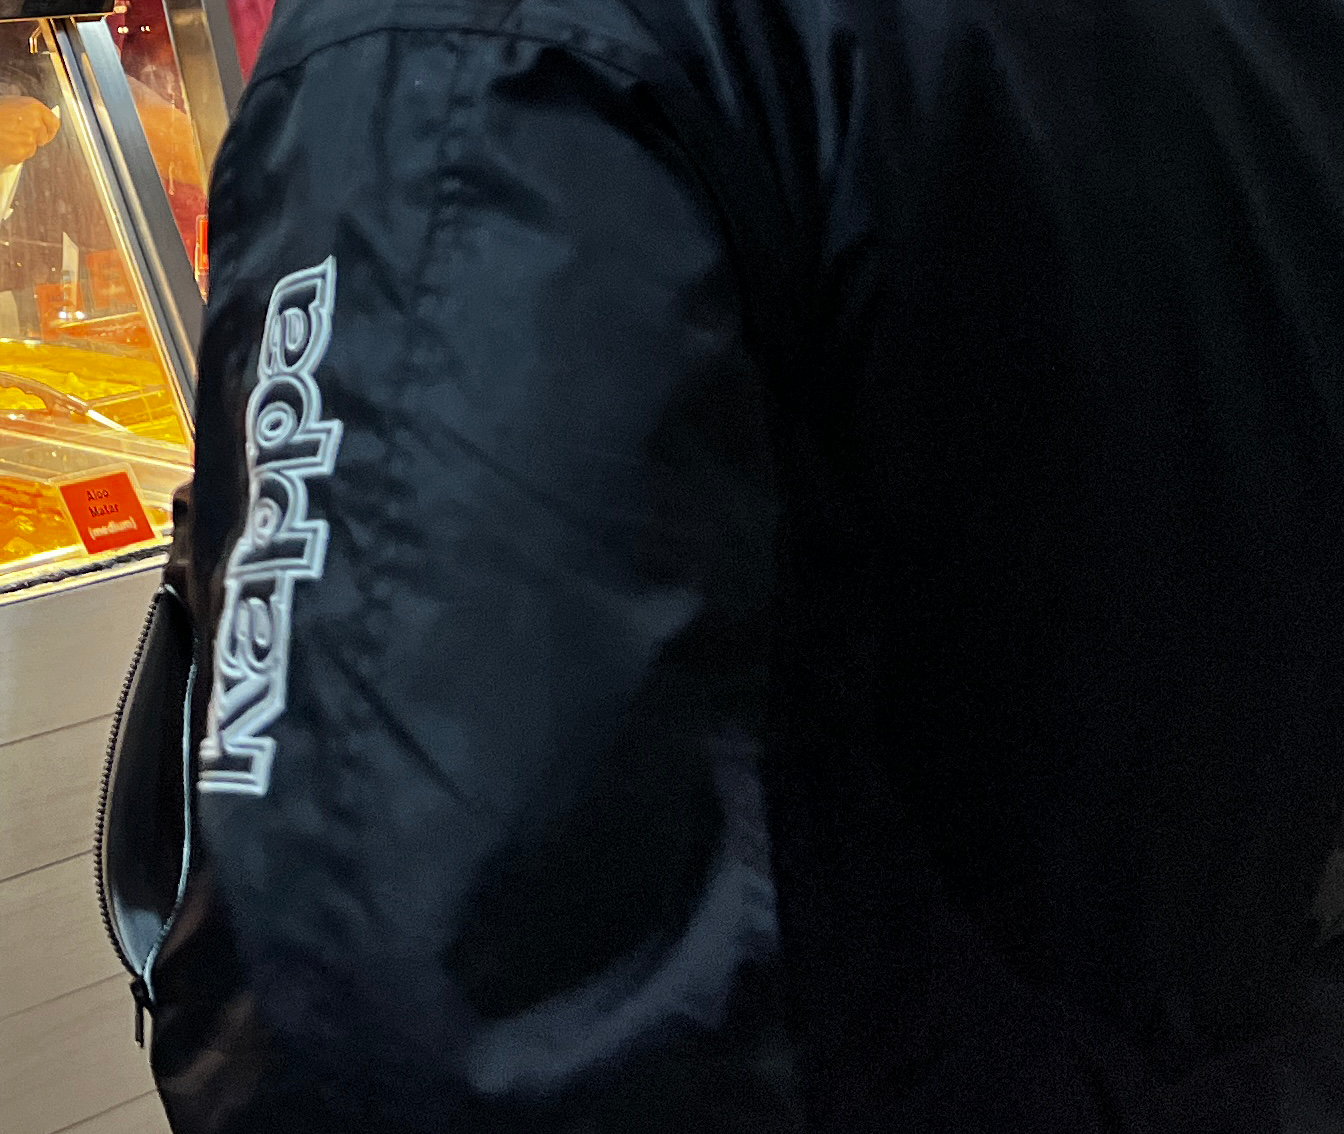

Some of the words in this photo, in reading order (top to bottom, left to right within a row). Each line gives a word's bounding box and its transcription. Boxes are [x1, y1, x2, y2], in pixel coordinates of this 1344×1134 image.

[87, 489, 108, 501] Aloo
[89, 504, 118, 517] Matar
[198, 256, 343, 796] Kappa
